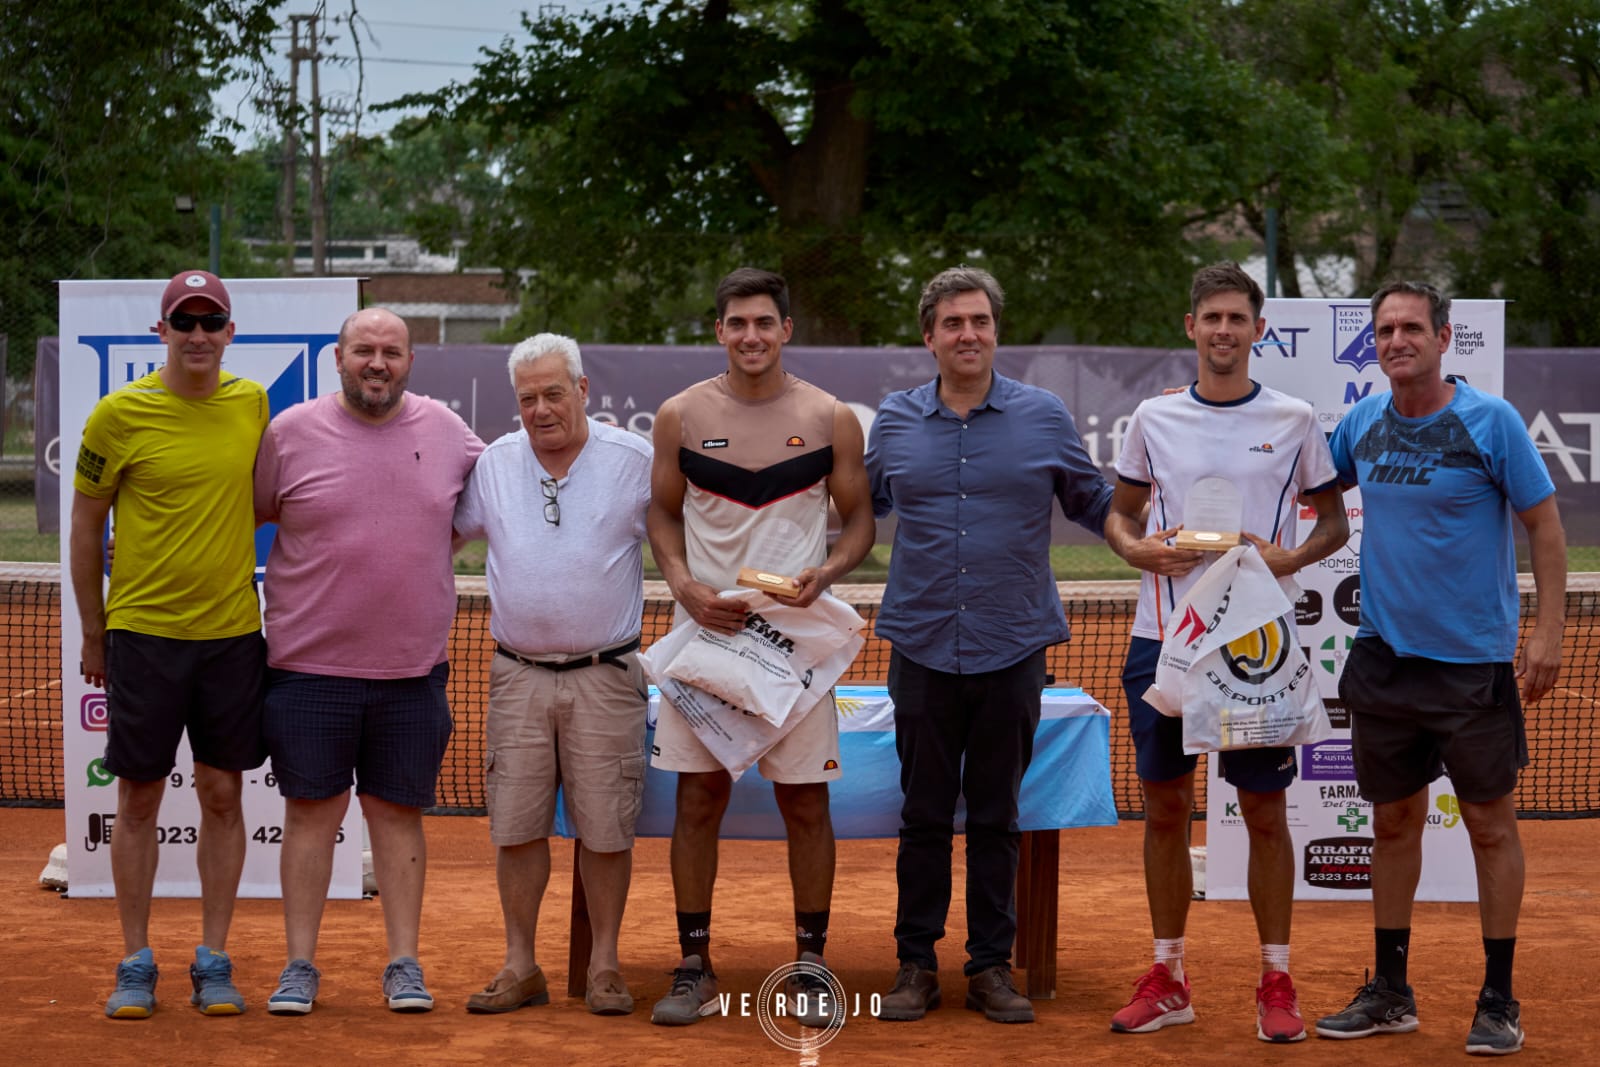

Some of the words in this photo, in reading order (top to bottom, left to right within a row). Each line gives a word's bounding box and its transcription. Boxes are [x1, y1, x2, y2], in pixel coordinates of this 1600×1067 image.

[1454, 331, 1483, 340] World
[1454, 339, 1485, 347] Tennis
[1454, 347, 1474, 355] Tour
[1206, 662, 1309, 706] DEPORTES
[1310, 873, 1342, 881] 2323
